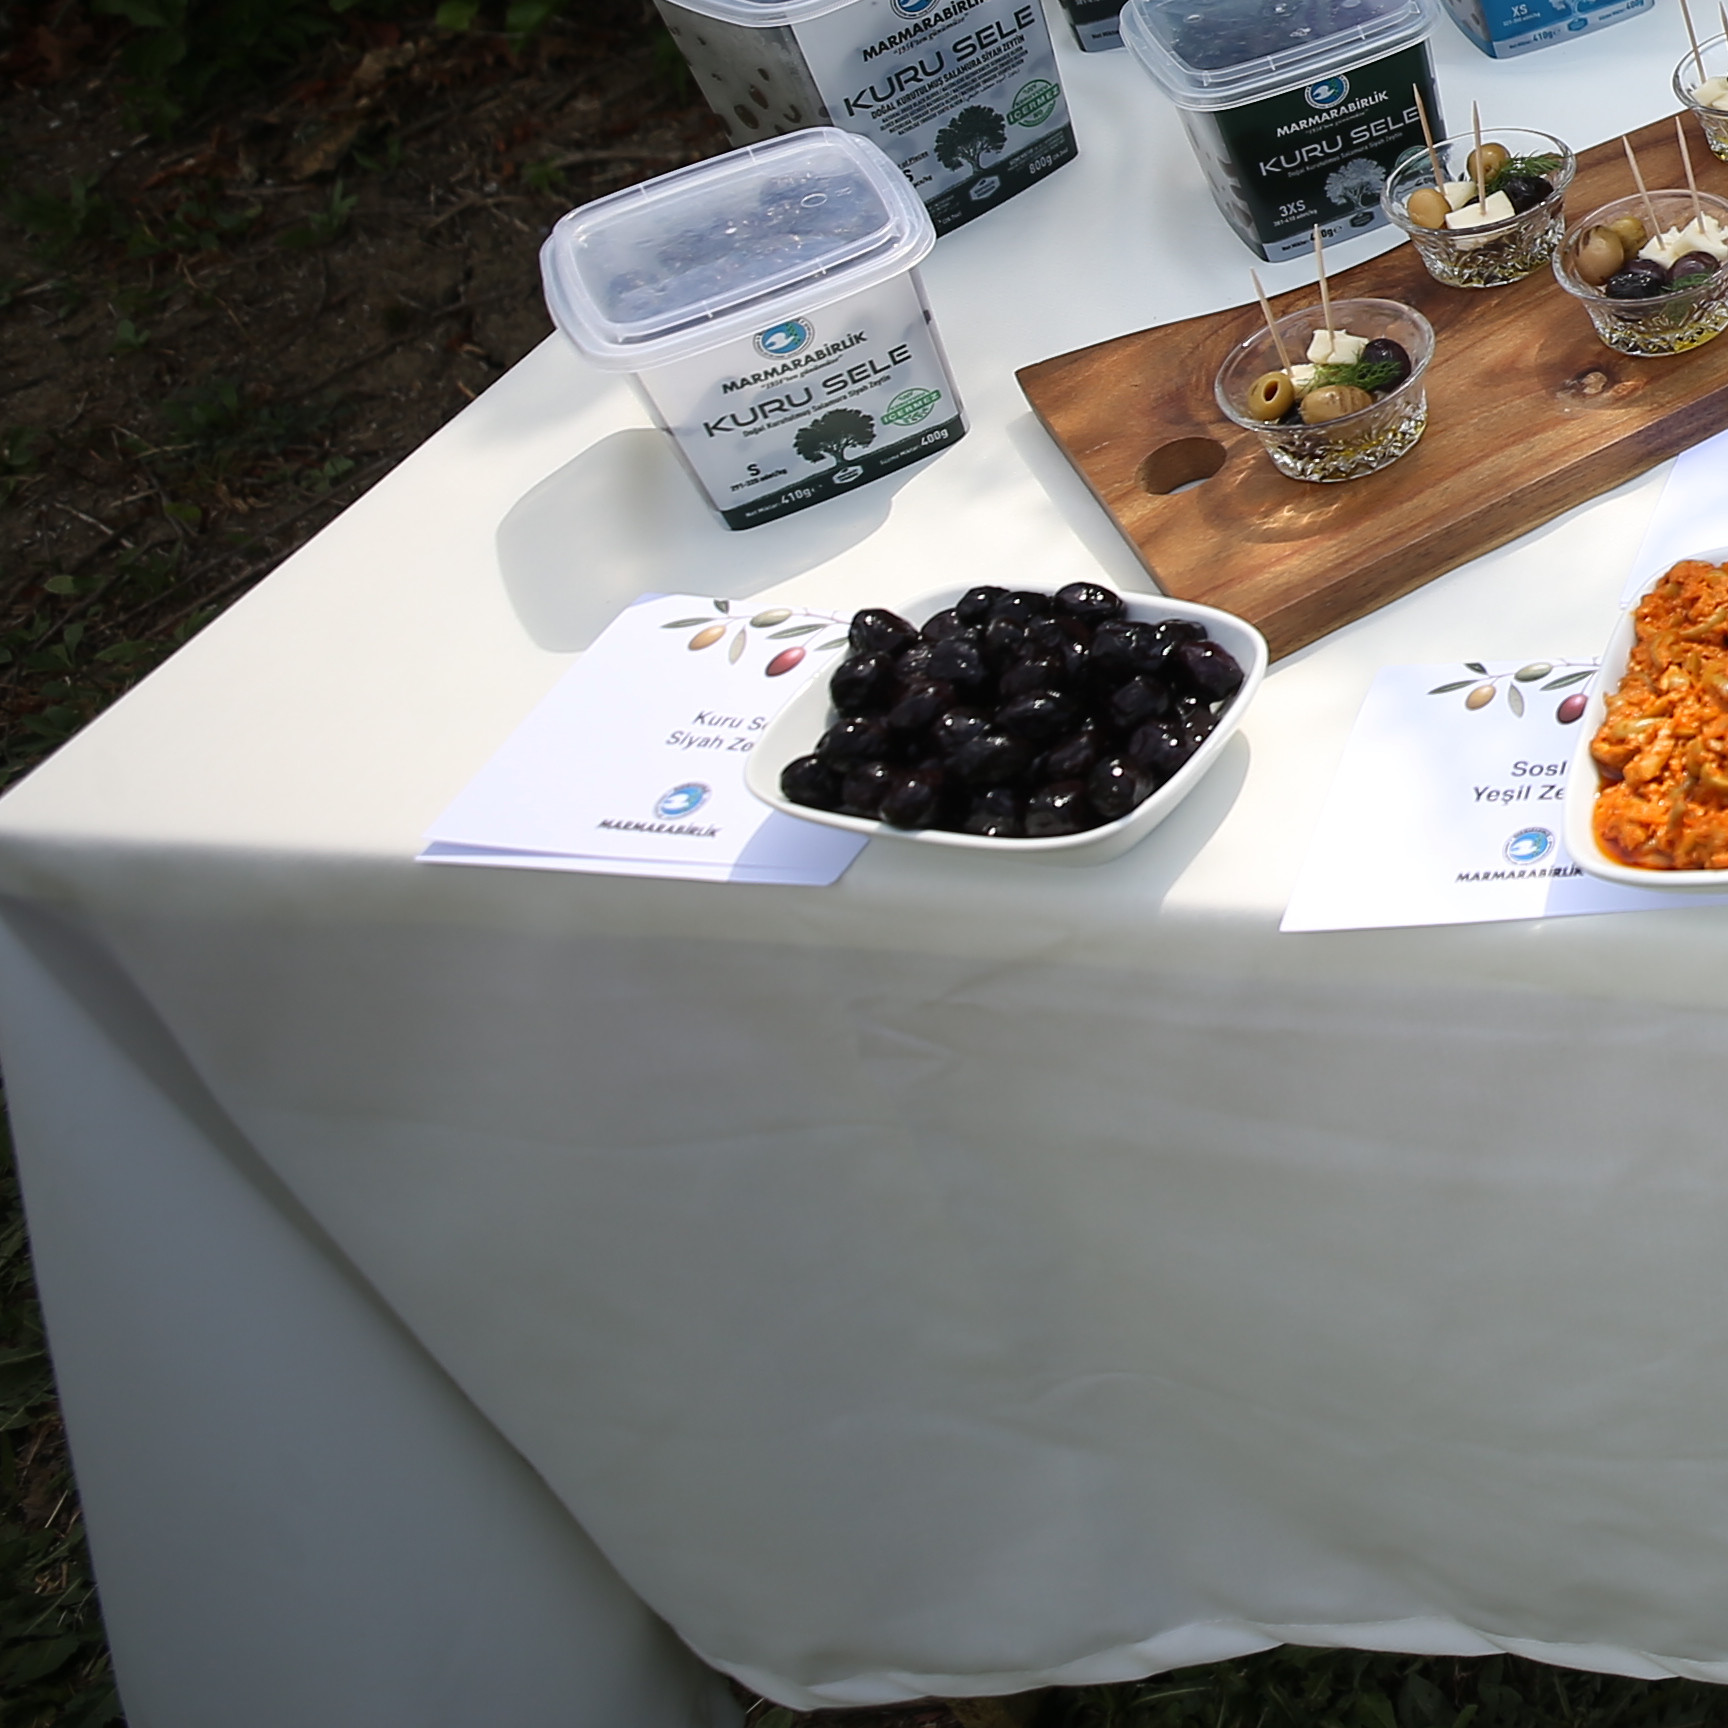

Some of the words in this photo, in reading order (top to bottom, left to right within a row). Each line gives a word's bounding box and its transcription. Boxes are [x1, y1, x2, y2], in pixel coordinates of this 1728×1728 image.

[1511, 4, 1528, 17] XS
[1533, 30, 1553, 42] 410g
[844, 52, 944, 117] KURU
[952, 5, 1035, 63] SELE
[1277, 90, 1389, 137] MARMARABİRLİK
[1259, 135, 1342, 176] KURU
[1351, 106, 1420, 144] SELE
[1029, 154, 1053, 174] 800g
[1279, 200, 1306, 217] 3XS
[722, 331, 868, 394] MARMARABİRLİK
[703, 387, 813, 437] KURU
[823, 344, 912, 395] SELE
[920, 429, 949, 447] 400g
[748, 463, 761, 476] S
[781, 488, 811, 505] 410g
[692, 710, 744, 729] Kuru
[666, 731, 724, 750] Siyah
[1510, 760, 1568, 777] Sosl
[1473, 786, 1531, 806] Yeşil
[598, 819, 723, 838] MARMARABİRLİK
[1455, 862, 1584, 883] MARMARABİRLİK
